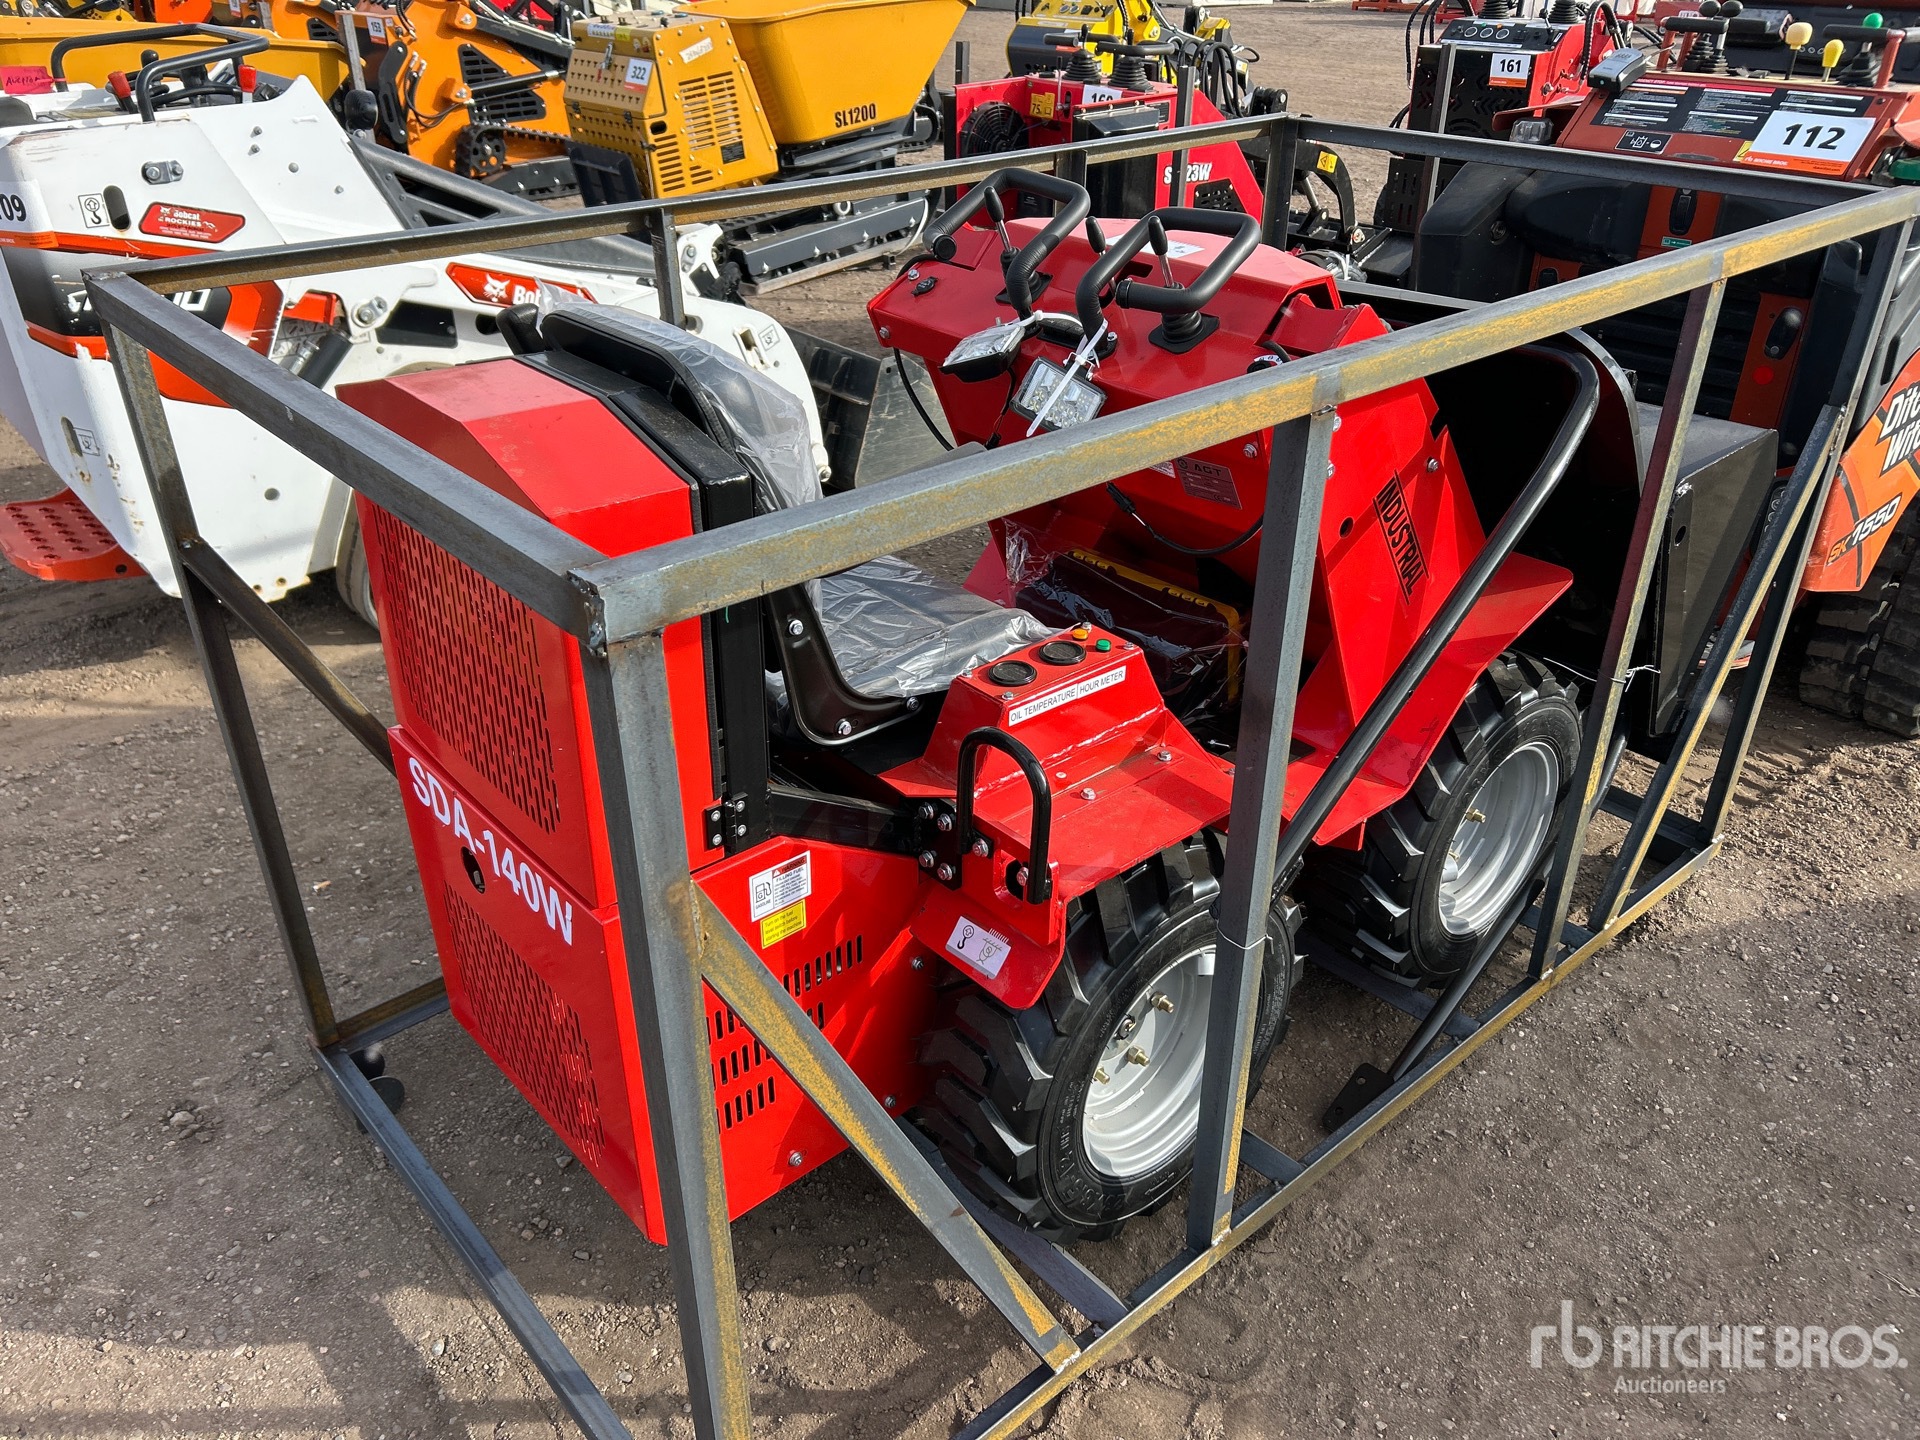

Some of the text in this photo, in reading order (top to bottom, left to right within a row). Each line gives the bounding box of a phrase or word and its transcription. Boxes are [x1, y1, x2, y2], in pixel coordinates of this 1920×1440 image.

[630, 66, 647, 80] 322
[1500, 59, 1522, 73] 161
[834, 103, 876, 128] SL1200
[1783, 123, 1846, 150] 112
[1163, 162, 1212, 185] S23W
[0, 194, 27, 222] 09
[1880, 385, 1920, 438] Ditc
[1882, 420, 1920, 471] Witc
[1194, 464, 1222, 477] AGT
[1852, 495, 1902, 546] 1550
[1376, 476, 1425, 596] INDUSTRIAL
[1010, 669, 1123, 722] OIL TEMPERATURE HOUR METER
[409, 757, 572, 946] SDA-140W
